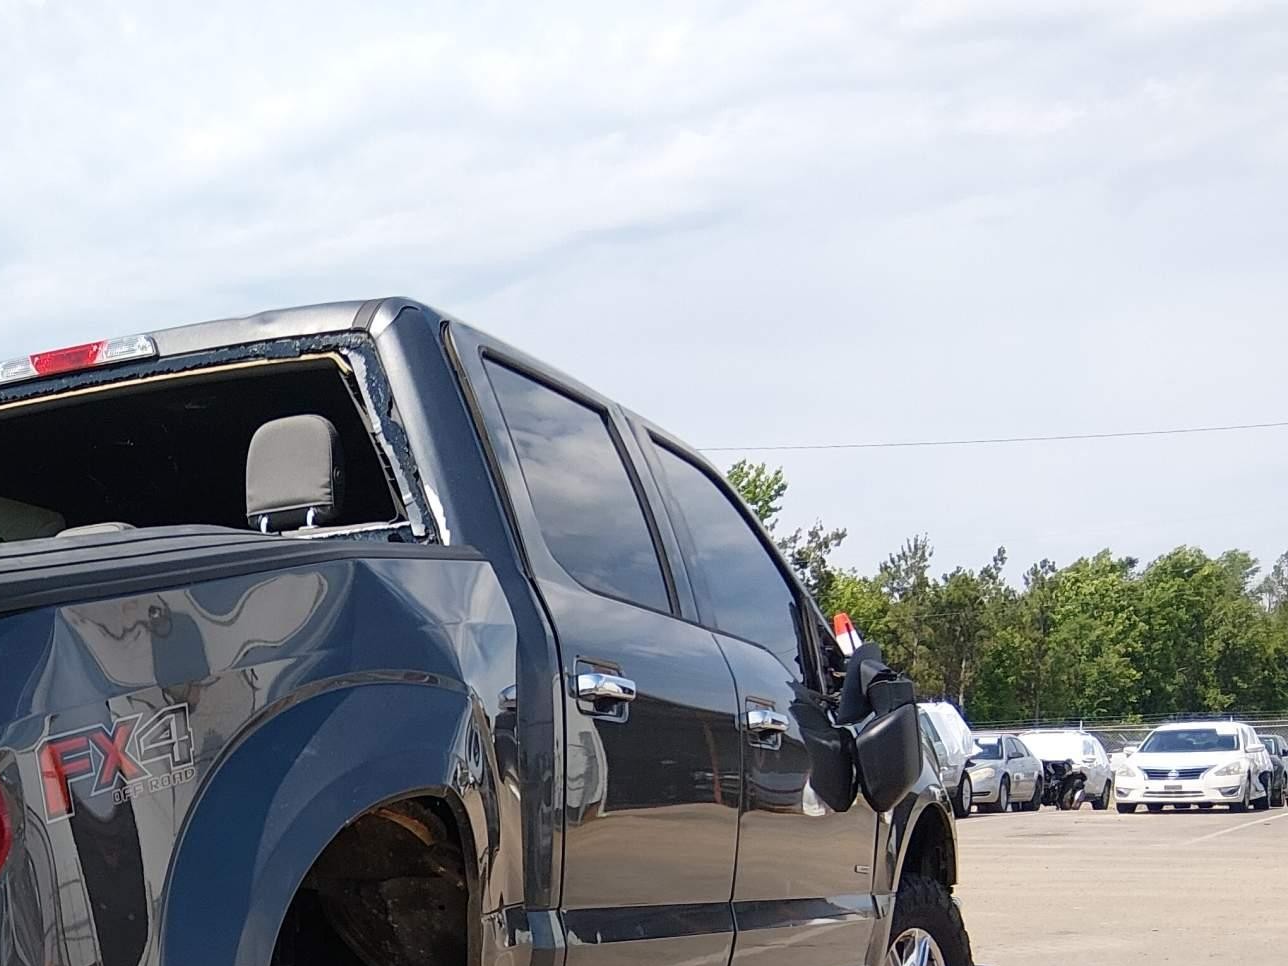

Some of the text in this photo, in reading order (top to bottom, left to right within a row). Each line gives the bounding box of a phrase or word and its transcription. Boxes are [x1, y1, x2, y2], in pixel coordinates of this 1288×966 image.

[34, 702, 196, 824] FX4
[112, 767, 196, 805] OFF ROAD
